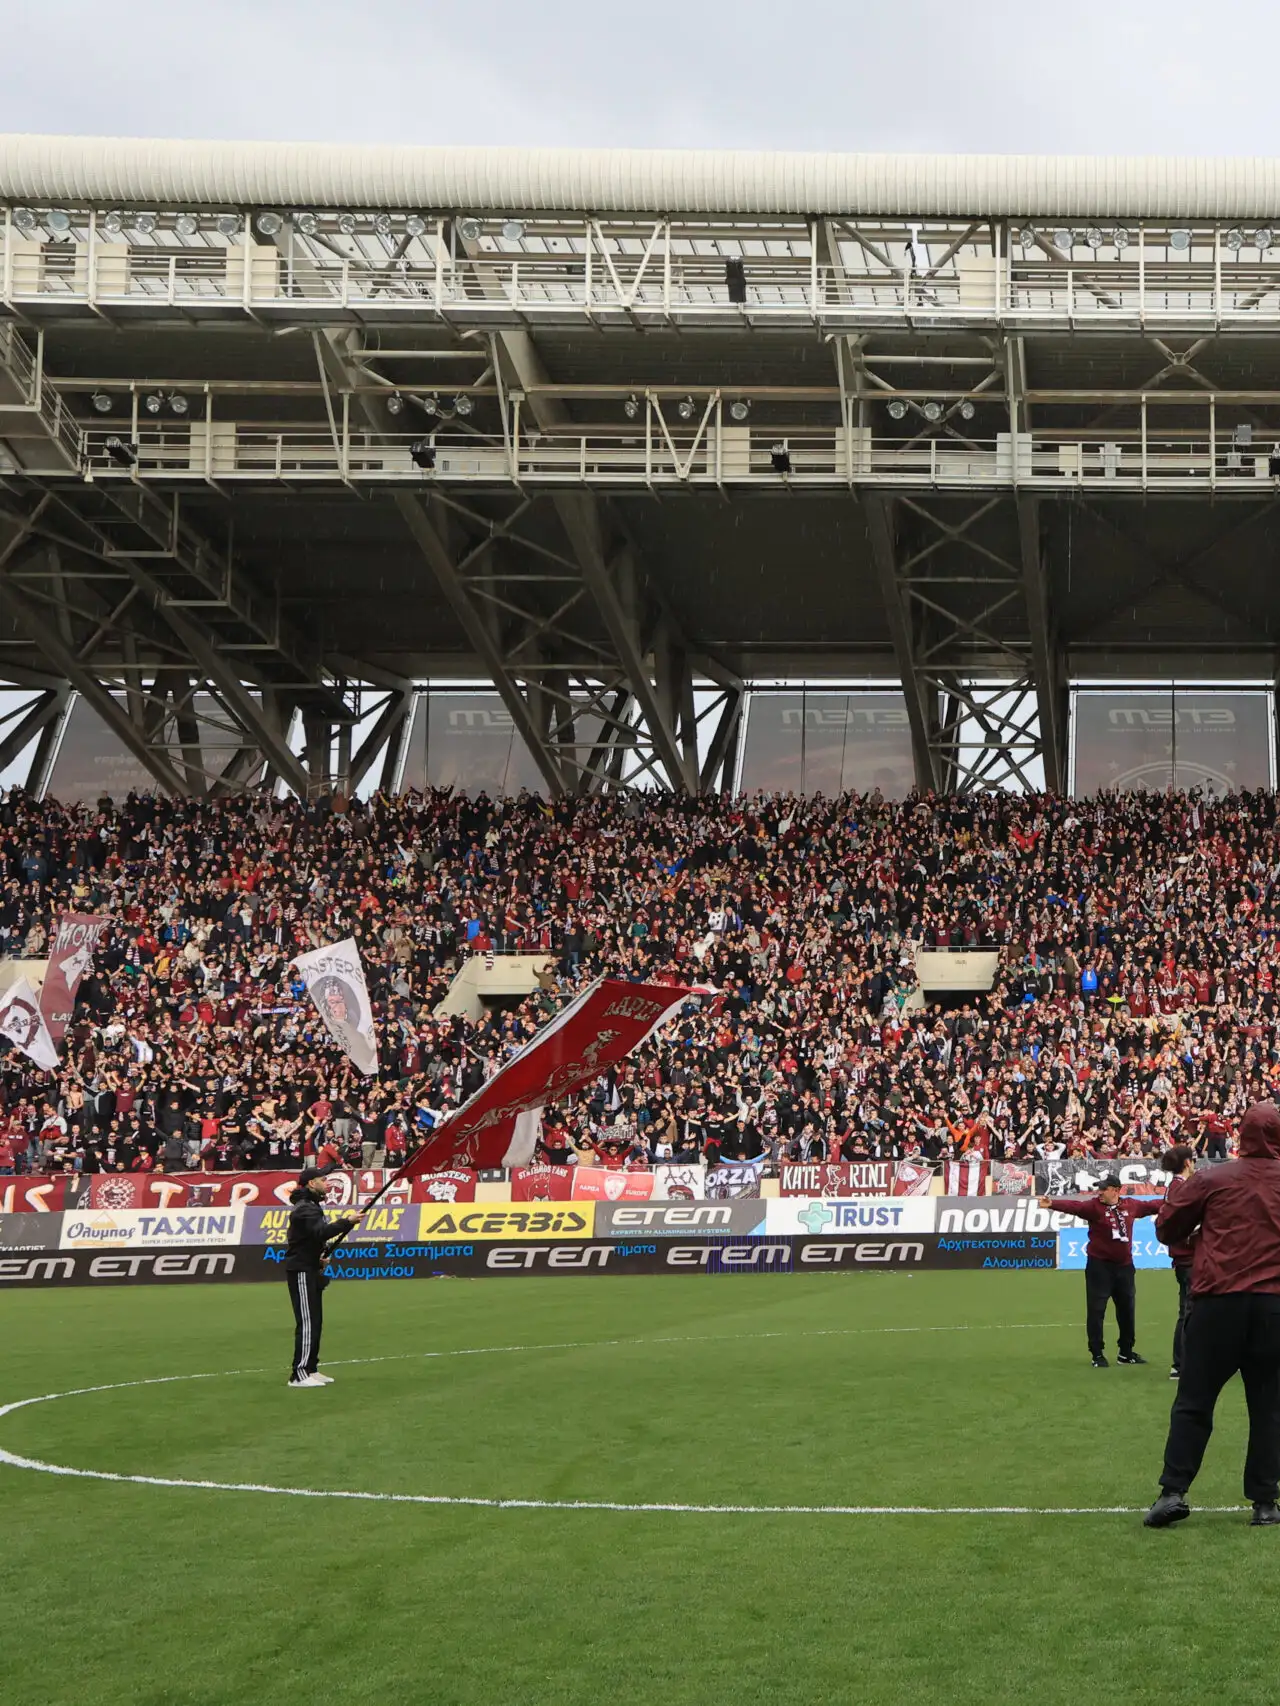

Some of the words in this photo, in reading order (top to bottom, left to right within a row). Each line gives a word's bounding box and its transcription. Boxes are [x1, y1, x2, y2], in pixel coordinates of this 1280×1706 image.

[138, 1215, 236, 1236] TAXINI
[260, 1211, 292, 1229] AUT
[611, 1206, 733, 1225] ETEM
[384, 1241, 474, 1261] Συστήματα
[667, 1244, 792, 1265] ETEM
[801, 1242, 925, 1263] ETEM
[937, 1237, 1026, 1252] Αρχιτεκτονικά
[89, 1253, 236, 1278] ETEM
[983, 1255, 1053, 1270] Αλουμινίου
